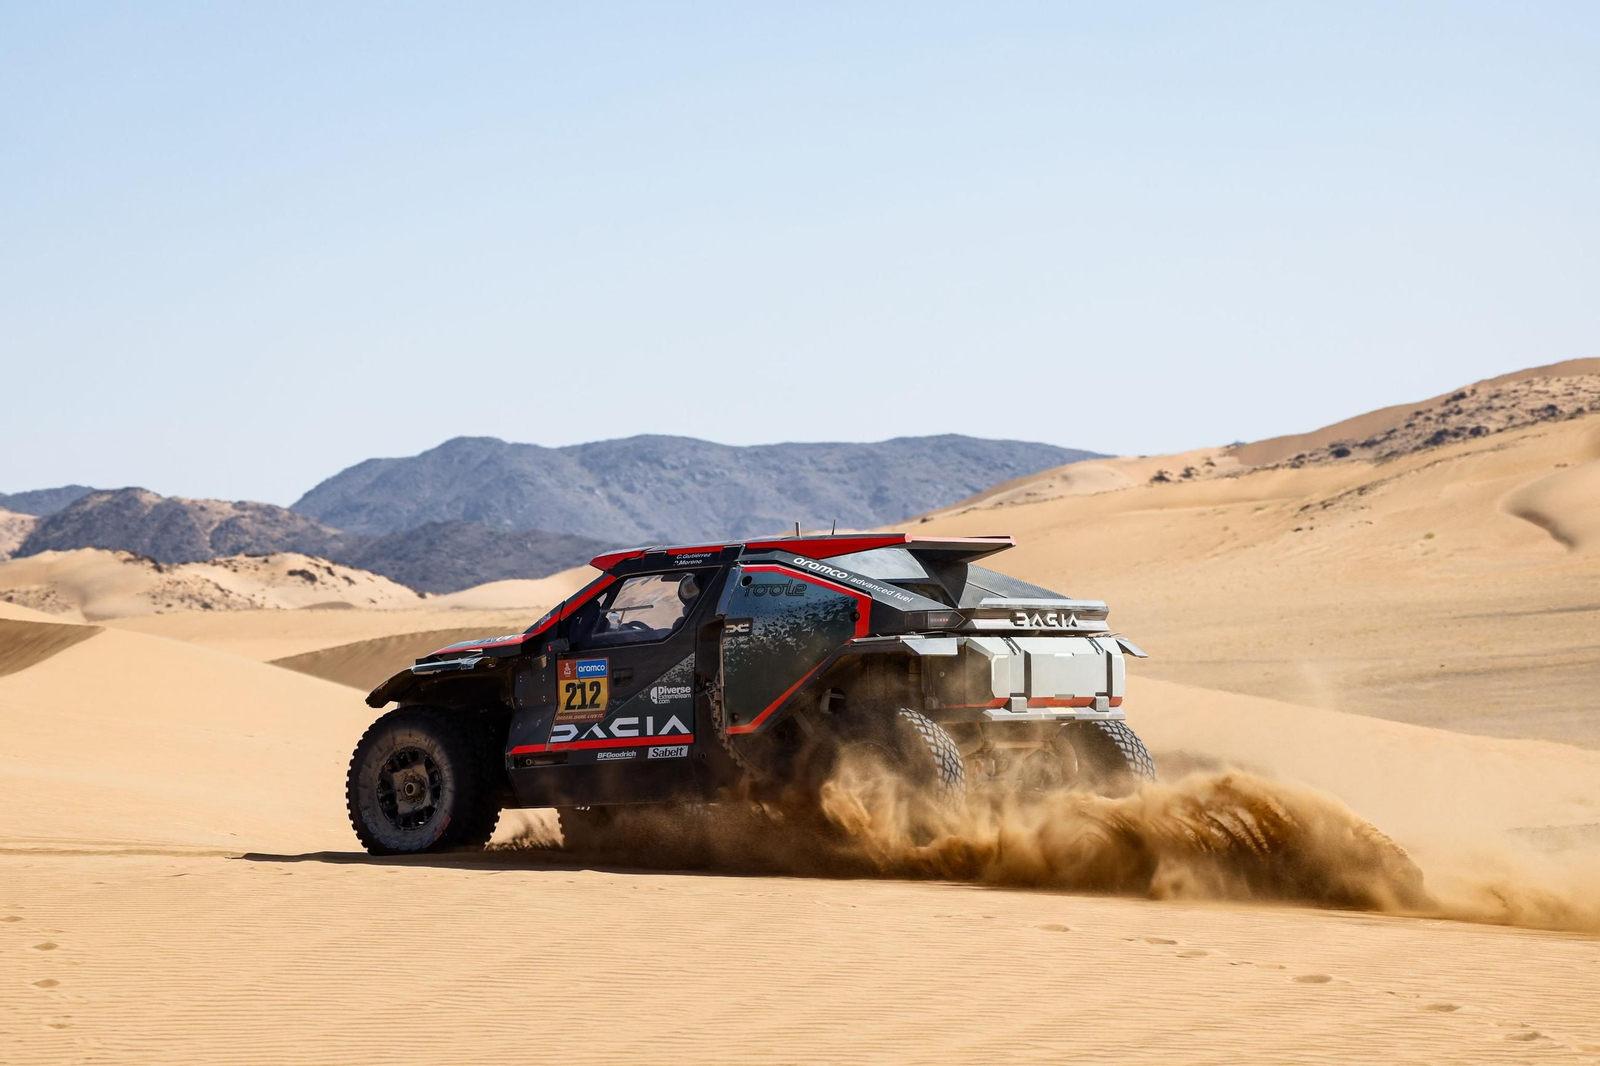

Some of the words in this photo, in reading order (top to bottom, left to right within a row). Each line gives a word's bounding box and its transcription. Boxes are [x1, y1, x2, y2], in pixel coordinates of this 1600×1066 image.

[793, 557, 848, 579] aramco
[850, 576, 893, 596] advanced
[894, 591, 914, 603] fuel
[1013, 612, 1078, 628] DACIA
[578, 664, 606, 673] aramco
[565, 681, 601, 710] 212
[658, 686, 691, 694] Diverse
[549, 714, 691, 742] DACIA
[597, 750, 637, 758] BFGoodrich
[652, 747, 684, 757] Sabelt
